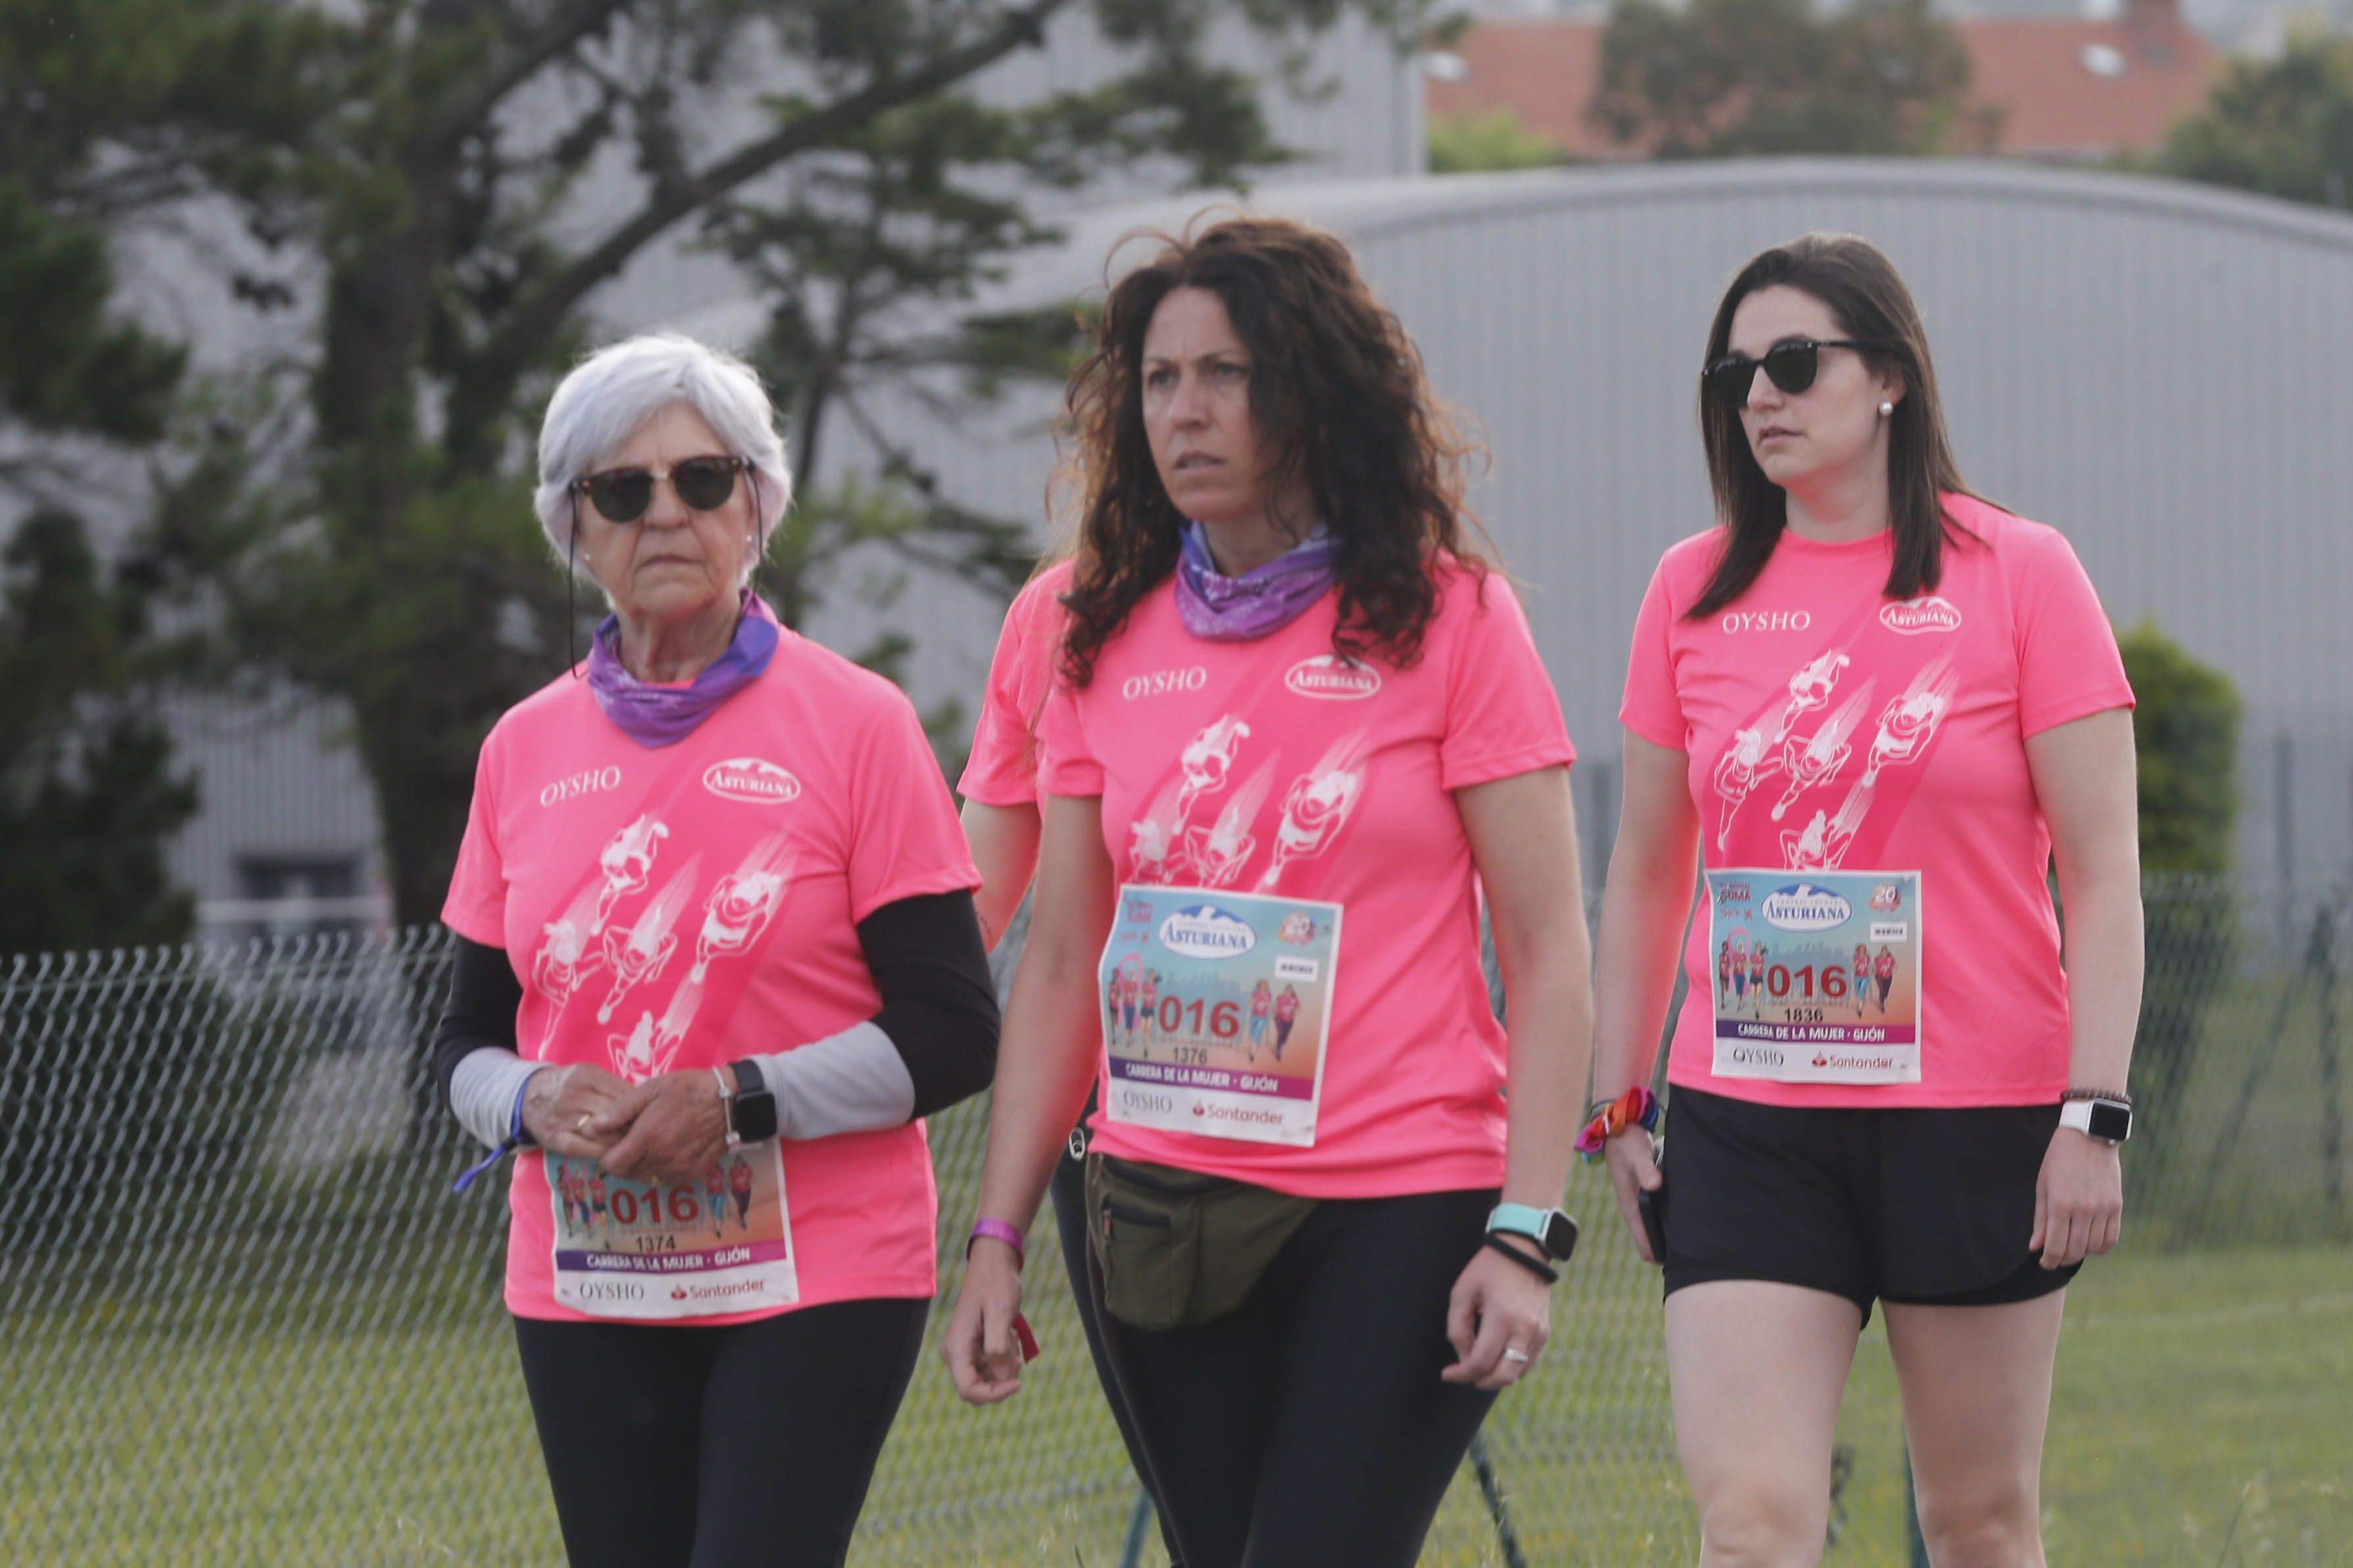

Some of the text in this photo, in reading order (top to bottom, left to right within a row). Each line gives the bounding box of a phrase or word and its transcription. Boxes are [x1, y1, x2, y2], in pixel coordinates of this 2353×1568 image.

[1722, 610, 1810, 635] OYSHO
[1887, 608, 1954, 627] ASTURIANA
[1123, 665, 1207, 700] OYSHO
[1292, 669, 1374, 694] ASTURIANA
[540, 765, 621, 807] OYSHO
[710, 769, 792, 798] ASTURIANA
[1766, 898, 1845, 919] ASTURIANA
[1162, 921, 1247, 949] ASTURIANA
[1767, 964, 1847, 998] 016
[1159, 996, 1241, 1039] 016
[1784, 1007, 1824, 1023] 1836
[1737, 1022, 1773, 1038] CARRERA
[1776, 1026, 1789, 1039] DE
[1791, 1026, 1806, 1039] LA
[1809, 1026, 1845, 1041] MUJER
[1853, 1025, 1885, 1041] GIJÓN
[1173, 1046, 1208, 1064] 1376
[1733, 1047, 1784, 1067] OYSHO
[1830, 1055, 1893, 1070] Santander
[1125, 1062, 1161, 1080] CARRERA
[1163, 1067, 1175, 1081] DE
[1177, 1068, 1190, 1083] LA
[1192, 1070, 1230, 1087] MUJER
[1240, 1072, 1278, 1092] GIJÓN
[1123, 1090, 1173, 1112] OYSHO
[1207, 1104, 1284, 1126] Santander
[611, 1185, 700, 1225] 016
[636, 1234, 676, 1252] 1374
[587, 1252, 632, 1270] CARRERA
[647, 1254, 660, 1270] LA
[663, 1252, 703, 1270] MUJER
[714, 1247, 750, 1267] GIJÓN
[579, 1281, 644, 1301] OYSHO
[689, 1279, 765, 1300] Santander
